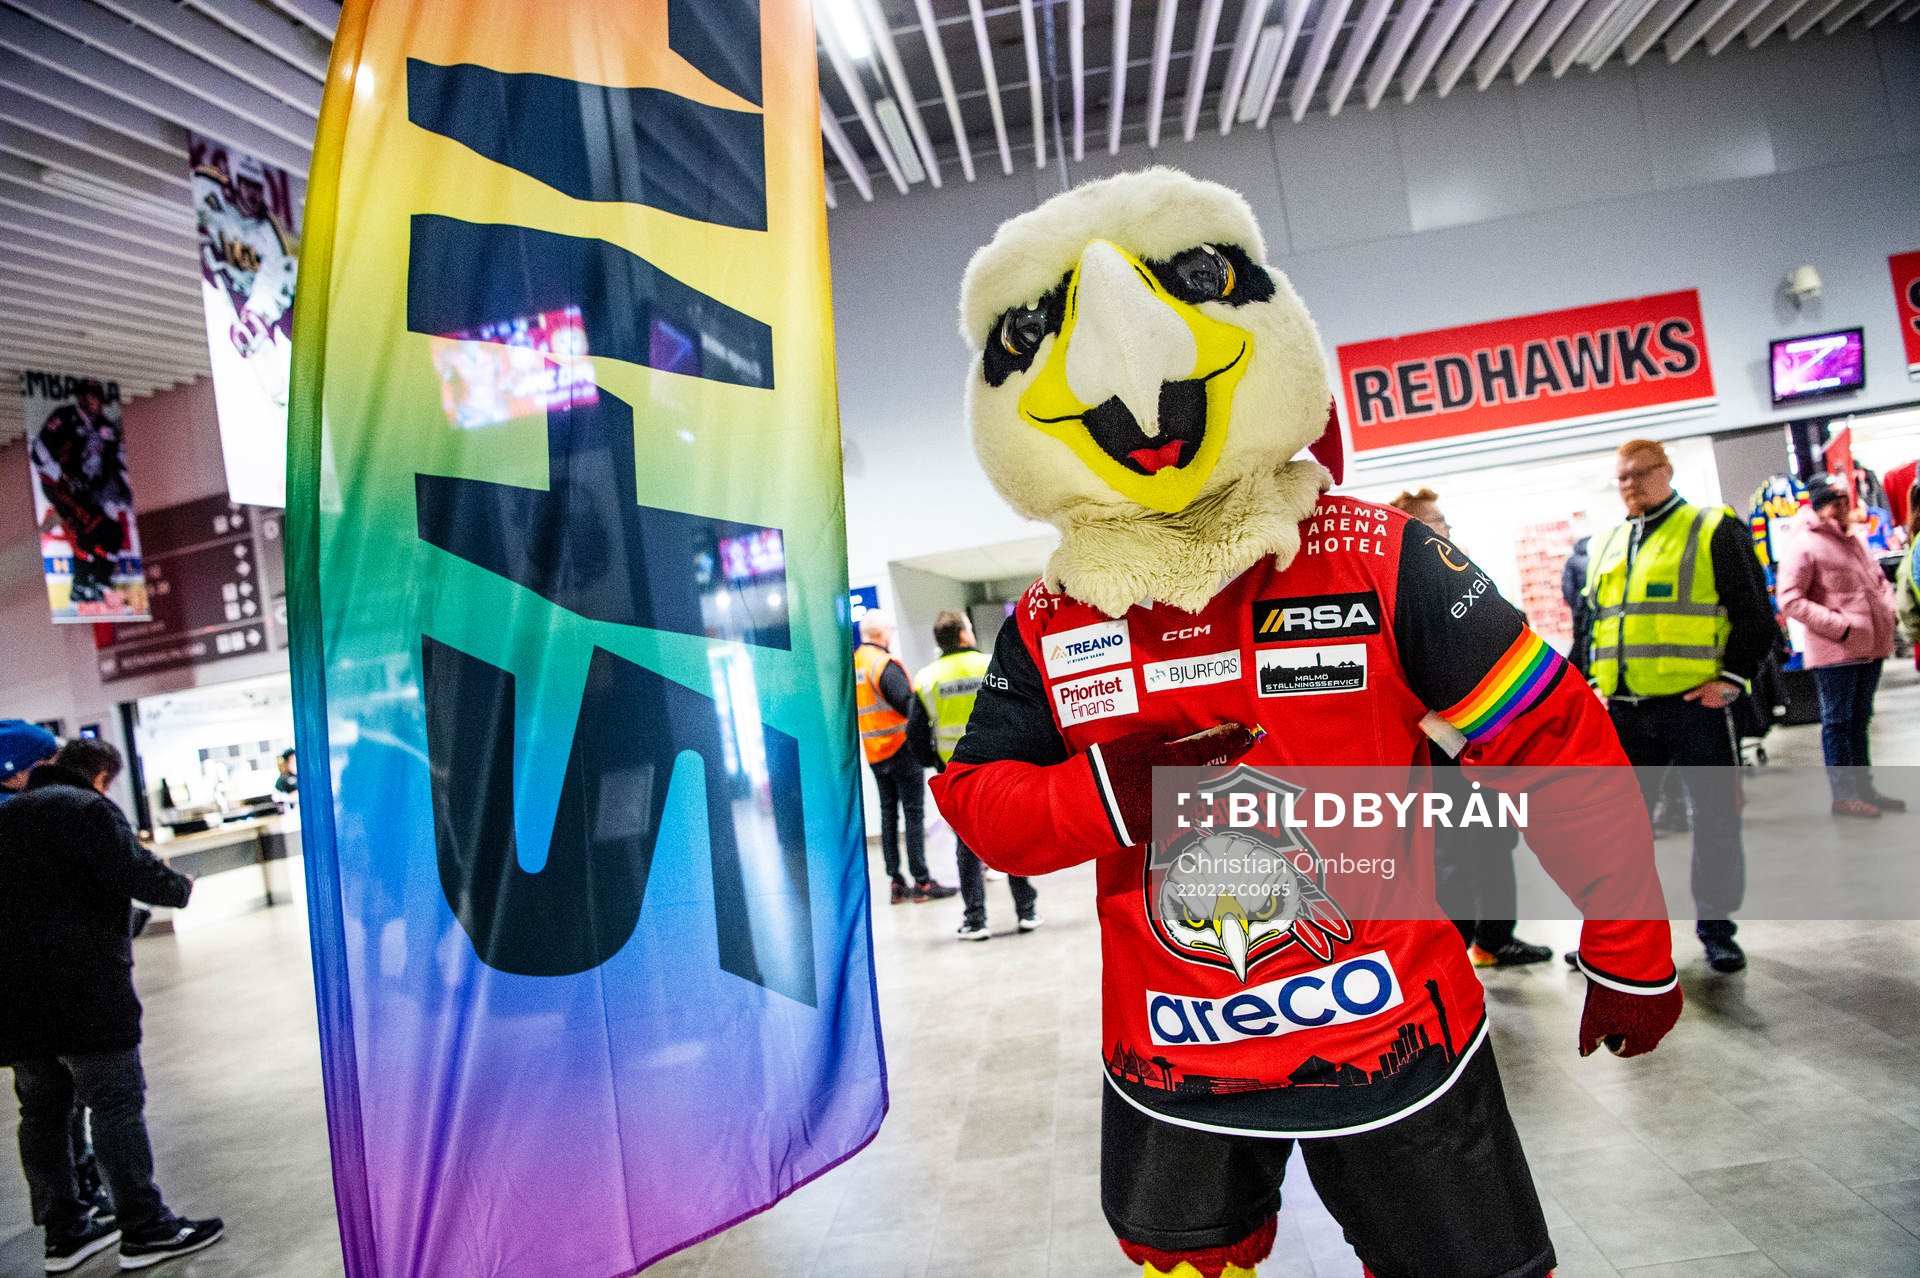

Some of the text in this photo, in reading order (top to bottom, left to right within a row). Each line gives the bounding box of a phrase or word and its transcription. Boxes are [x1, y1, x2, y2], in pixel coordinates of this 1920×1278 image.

[1352, 317, 1700, 426] REDHAWKS
[1307, 518, 1388, 537] ARENA
[1307, 536, 1386, 557] HOTEL
[1450, 571, 1491, 619] exak
[1282, 602, 1376, 632] RSA
[1065, 634, 1124, 656] TREANO
[1161, 624, 1212, 642] CCM
[1169, 657, 1238, 683] BJURFORS
[1295, 672, 1329, 682] MALMÖ
[1060, 676, 1123, 705] Prioritet
[1070, 698, 1115, 719] Finans
[1149, 958, 1393, 1044] areco
